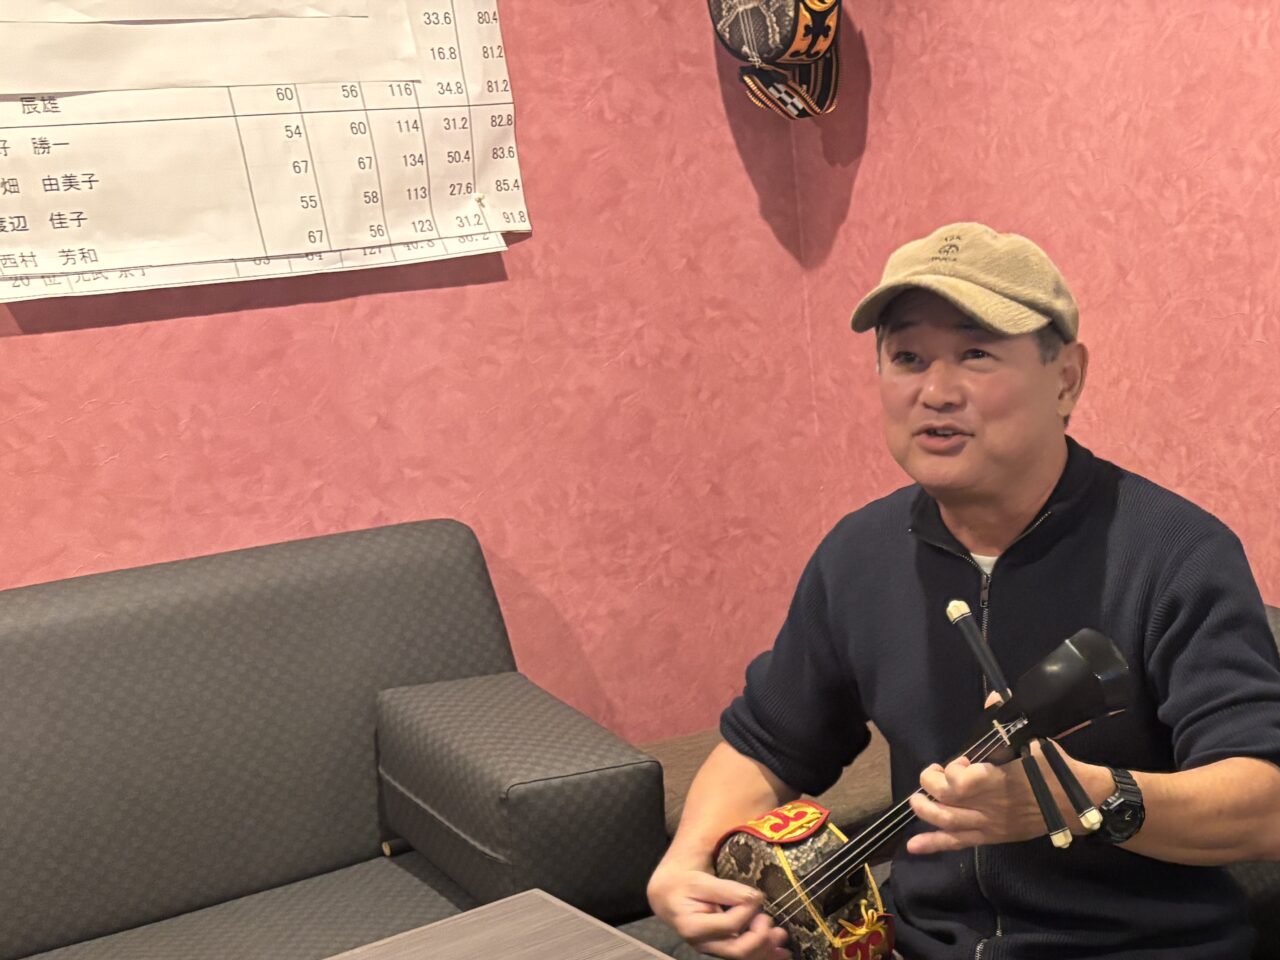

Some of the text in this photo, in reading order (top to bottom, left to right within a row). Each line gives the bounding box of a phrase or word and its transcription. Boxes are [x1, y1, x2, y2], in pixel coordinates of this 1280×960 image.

[423, 11, 498, 25] 33.6 80.4
[430, 45, 504, 60] 16.8 81.2
[276, 87, 294, 101] 60
[341, 84, 358, 98] 56
[388, 83, 412, 96] 116
[436, 81, 464, 95] 34.8
[487, 79, 510, 93] 81.2
[284, 124, 302, 139] 54
[350, 121, 367, 135] 60
[397, 119, 420, 133] 114
[443, 117, 469, 130] 31.2
[490, 114, 513, 128] 82.8
[42, 173, 100, 192] 由美子
[292, 160, 309, 174] 67
[357, 156, 373, 170] 67
[402, 153, 424, 167] 134
[447, 150, 471, 163] 50.4
[492, 146, 515, 159] 83.6
[49, 211, 88, 230] 佳子
[300, 195, 318, 209] 55
[363, 190, 379, 204] 58
[406, 186, 428, 200] 113
[449, 182, 473, 196] 27.6
[495, 178, 520, 192] 85.4
[0, 251, 38, 268] 西村
[308, 229, 324, 243] 67
[369, 224, 385, 238] 56
[411, 219, 434, 233] 123
[455, 213, 483, 228] 31.2
[502, 210, 526, 224] 91.8
